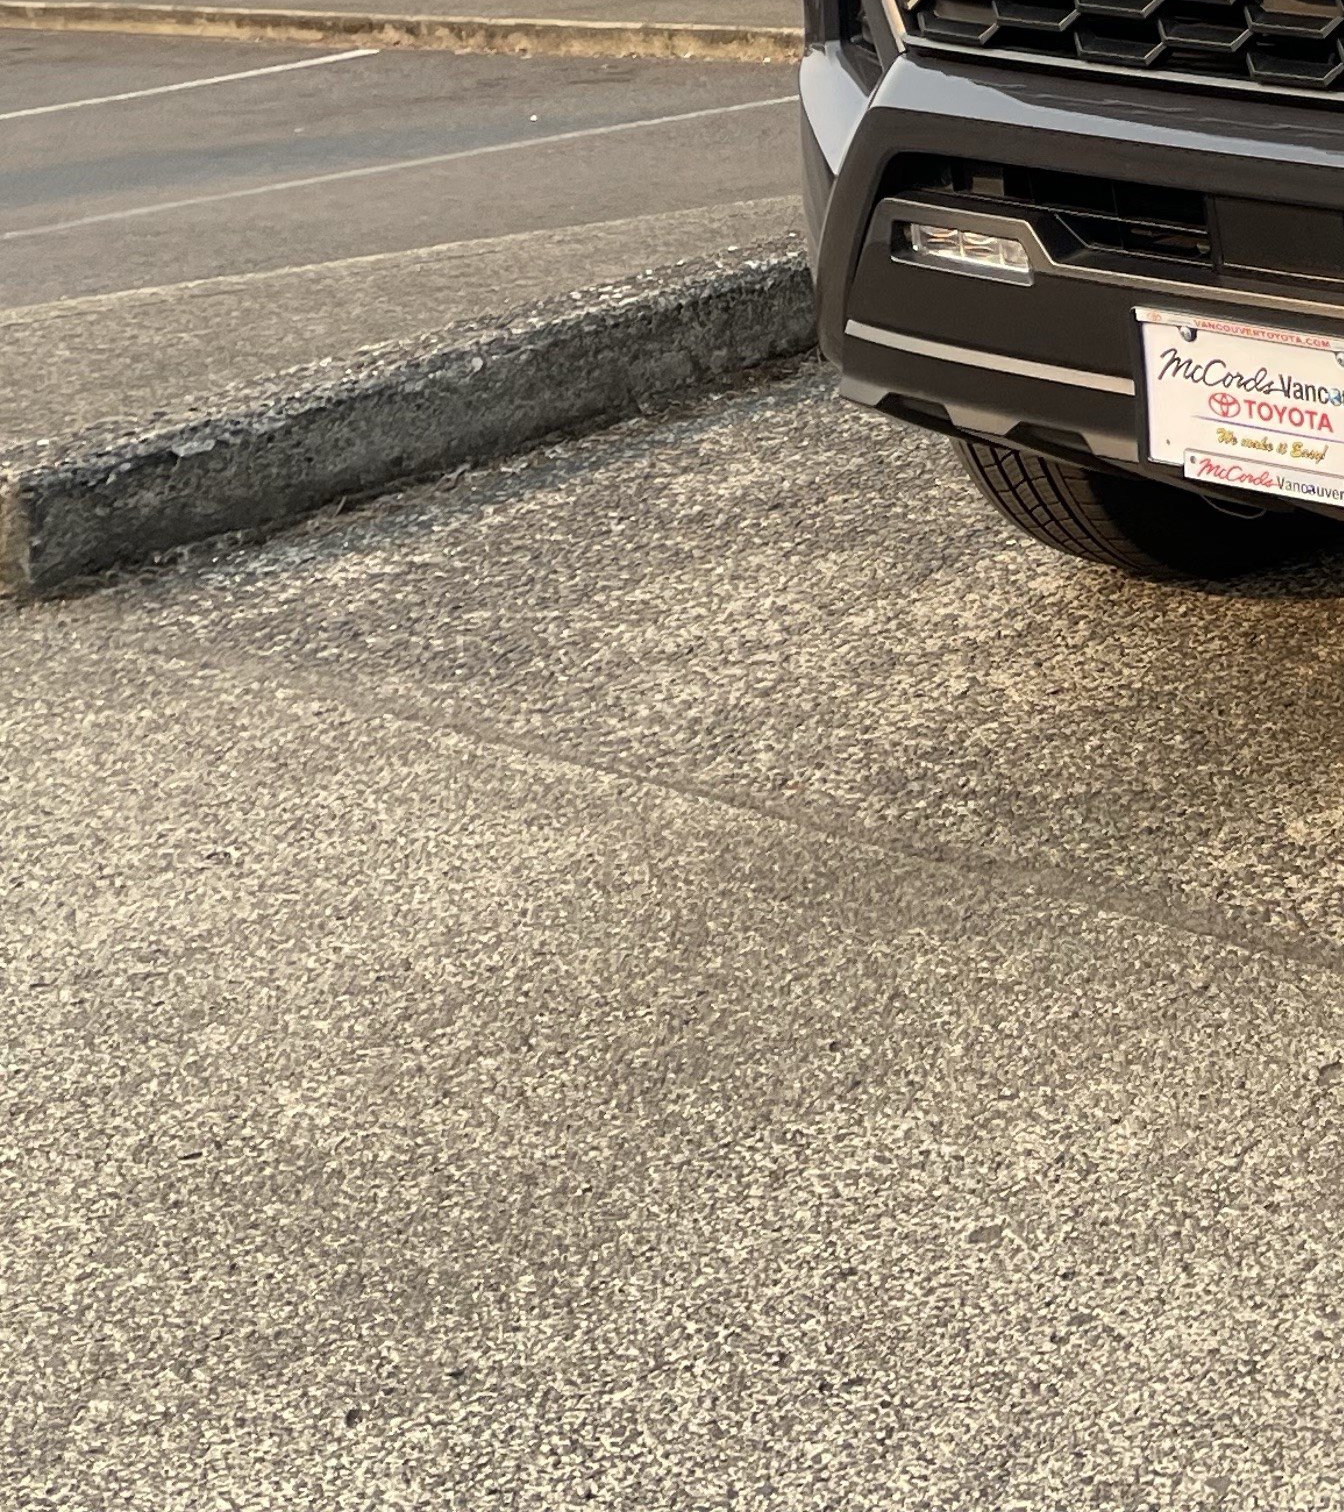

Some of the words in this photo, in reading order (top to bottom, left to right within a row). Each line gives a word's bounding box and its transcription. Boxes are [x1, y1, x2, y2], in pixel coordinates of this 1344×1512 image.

[1194, 319, 1332, 349] VANCOUVERTOYOTA.COM
[1243, 398, 1334, 434] TOYOTA
[1241, 436, 1273, 452] make
